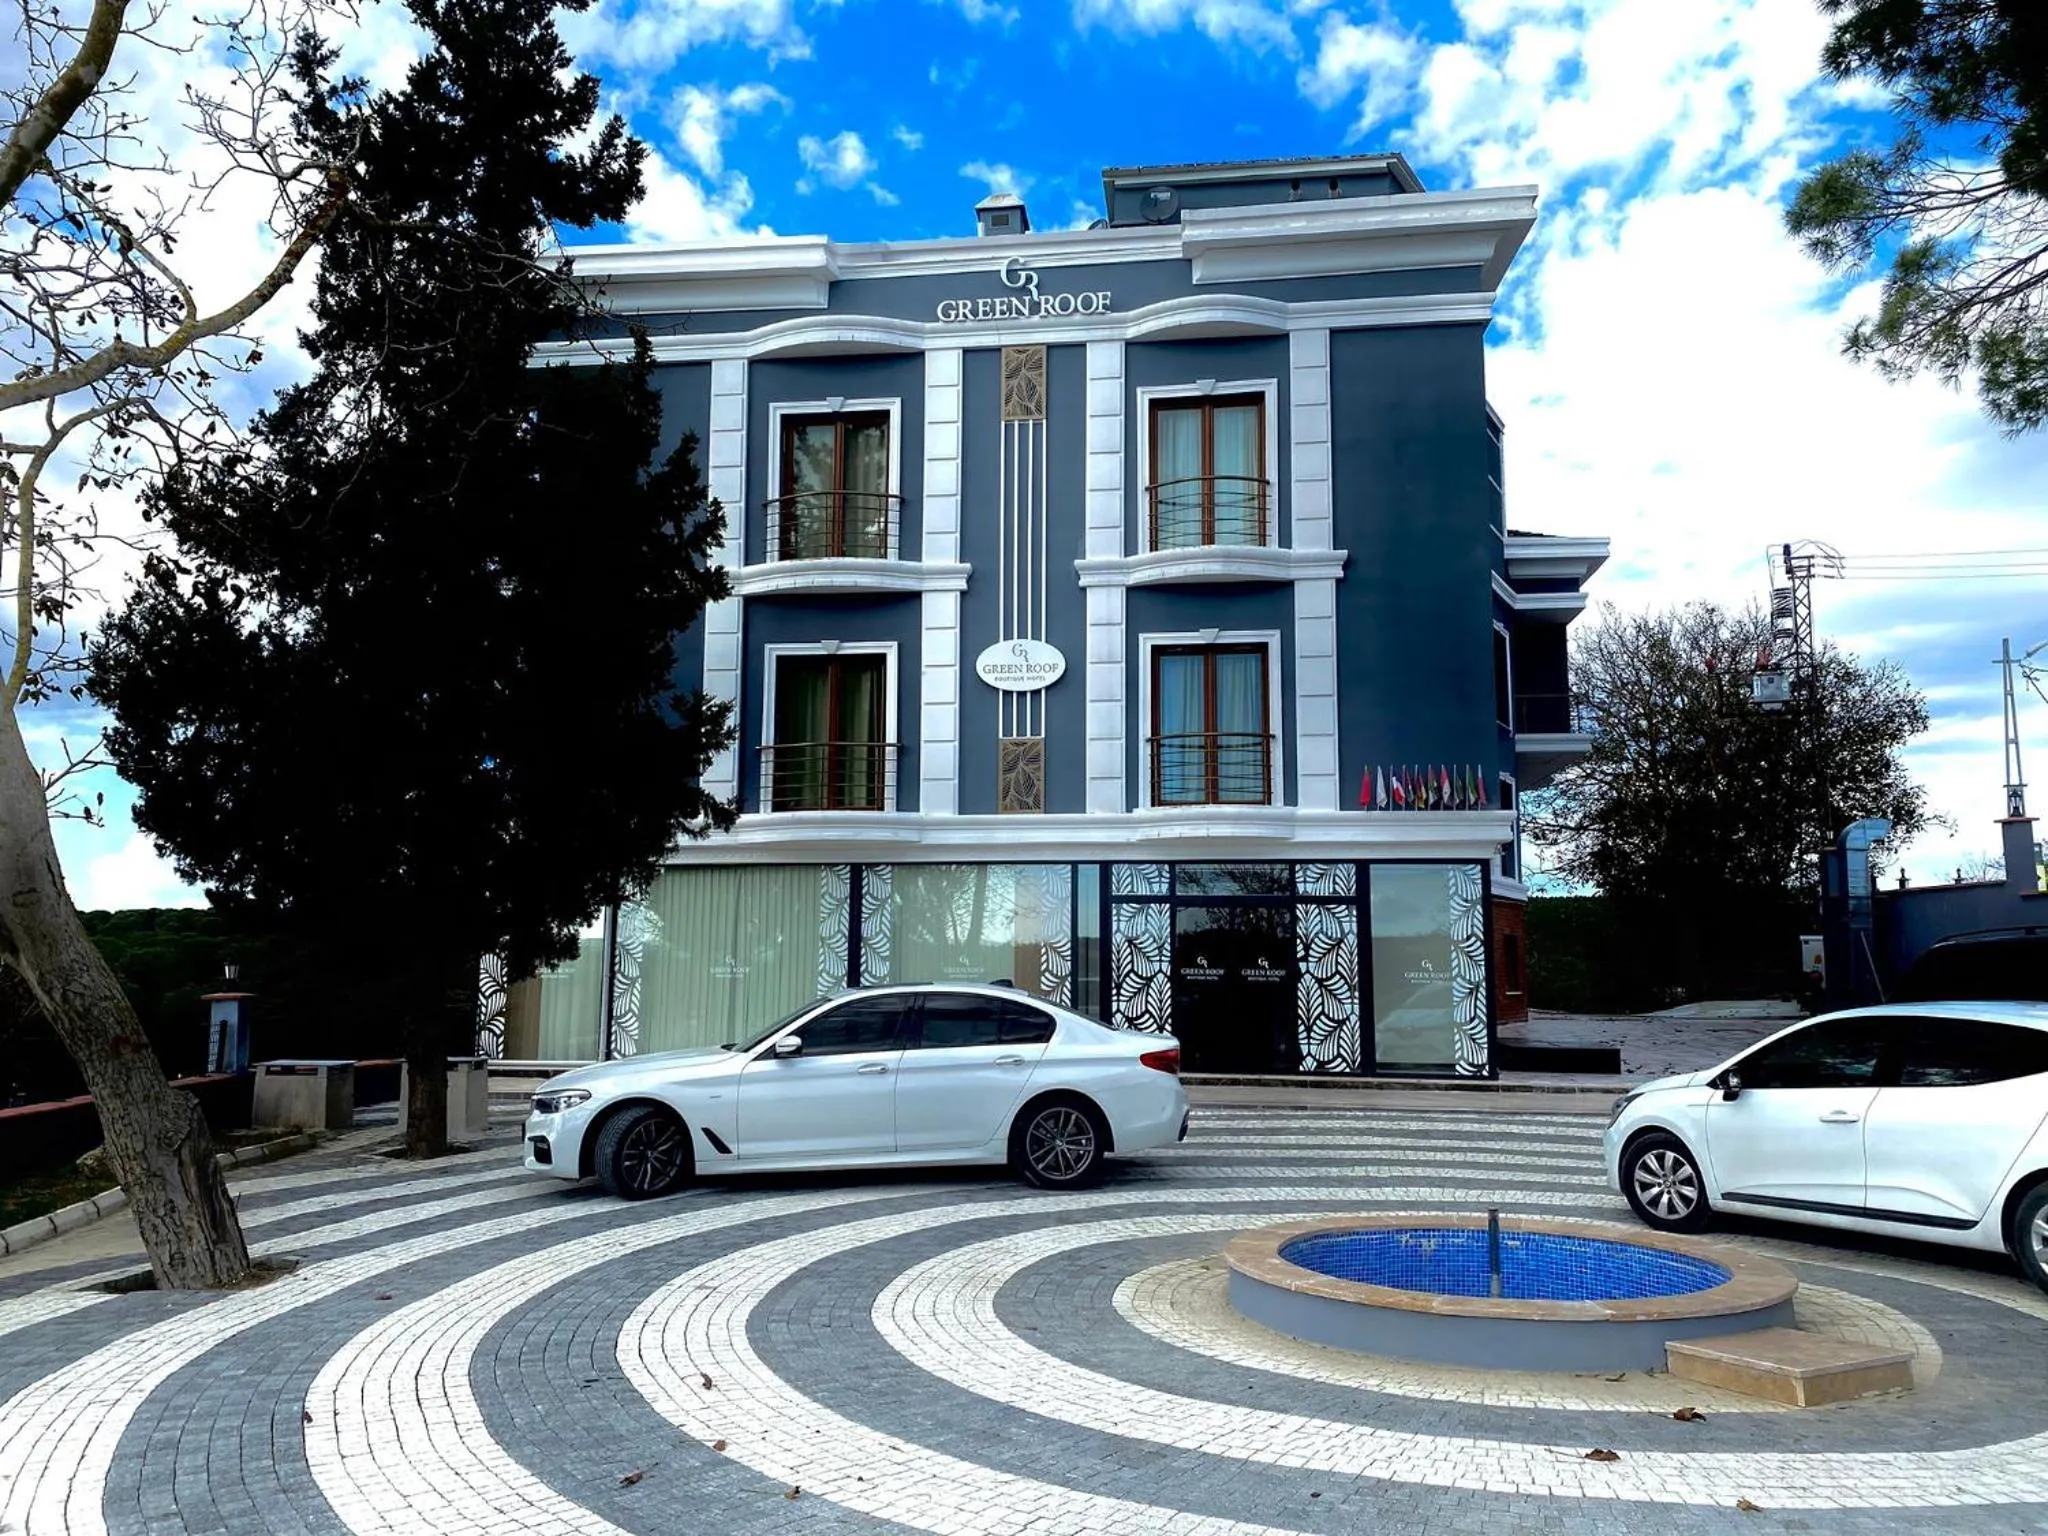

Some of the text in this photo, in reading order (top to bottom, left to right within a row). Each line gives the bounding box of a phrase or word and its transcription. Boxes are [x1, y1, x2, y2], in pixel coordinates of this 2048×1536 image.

[936, 291, 1112, 322] GREEN ROOF
[982, 663, 1059, 674] GREEN ROOF
[1180, 967, 1205, 976] GREEN
[1241, 968, 1265, 977] GREEN
